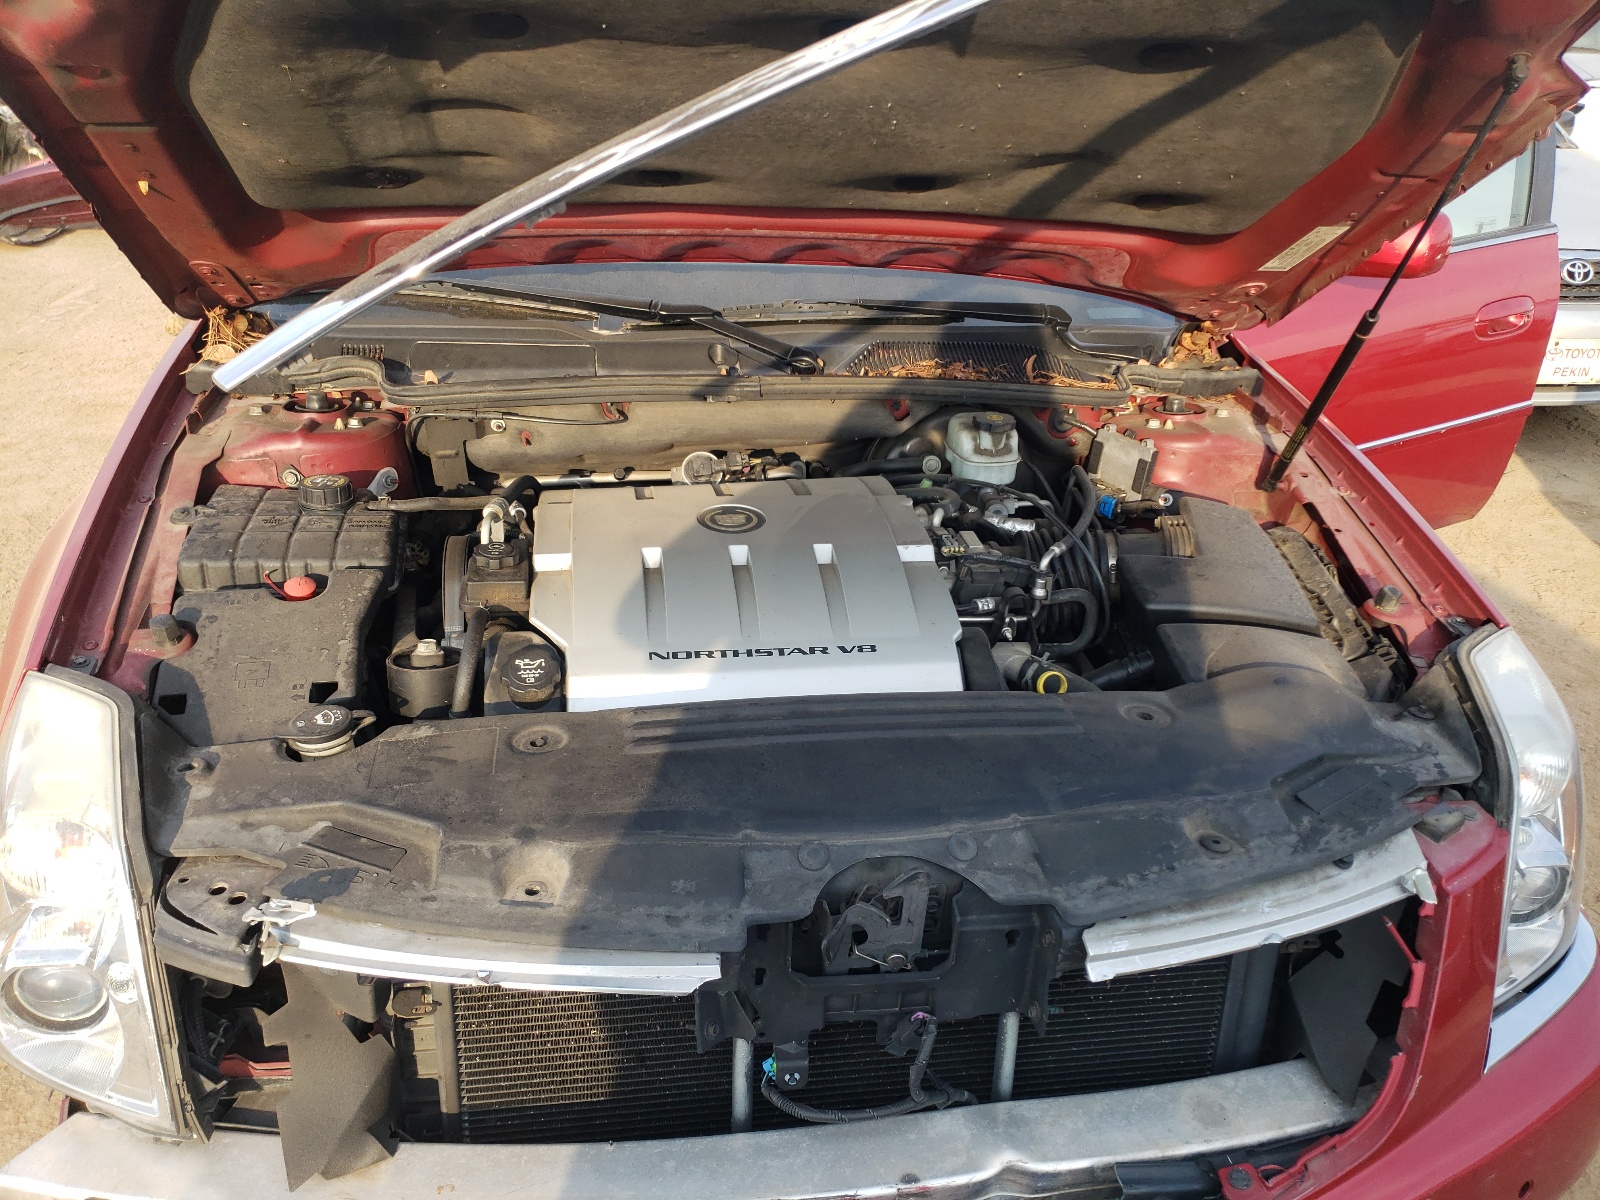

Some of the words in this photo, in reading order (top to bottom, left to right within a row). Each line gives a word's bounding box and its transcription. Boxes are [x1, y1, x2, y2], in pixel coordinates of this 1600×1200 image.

[1552, 367, 1590, 377] PEKIN
[649, 646, 830, 660] NORTHSTAR
[836, 644, 877, 654] V8
